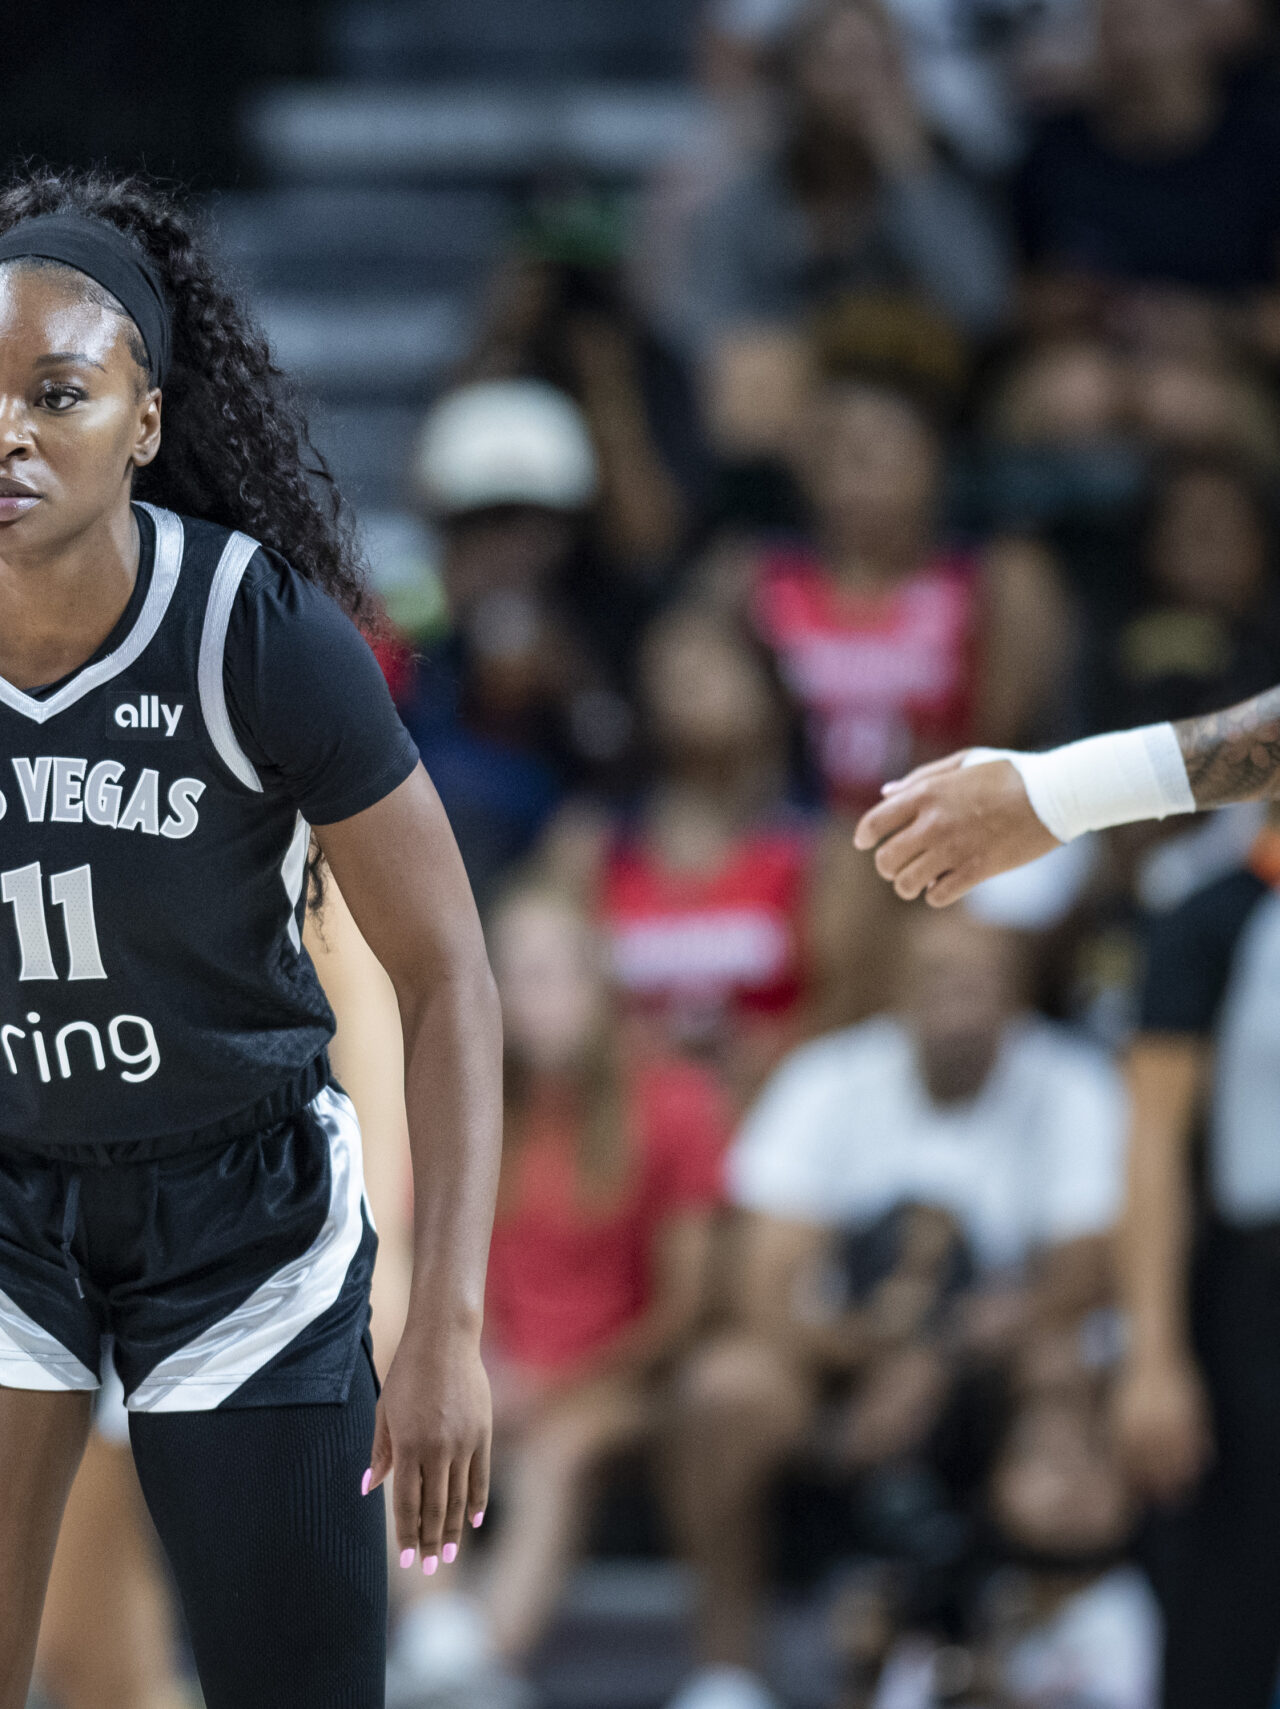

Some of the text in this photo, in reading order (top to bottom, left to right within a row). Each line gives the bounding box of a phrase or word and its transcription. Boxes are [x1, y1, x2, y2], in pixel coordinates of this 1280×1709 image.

[114, 695, 184, 737] ally
[11, 756, 207, 840] VEGAS
[0, 861, 108, 982] 11
[0, 1011, 161, 1083] ring
